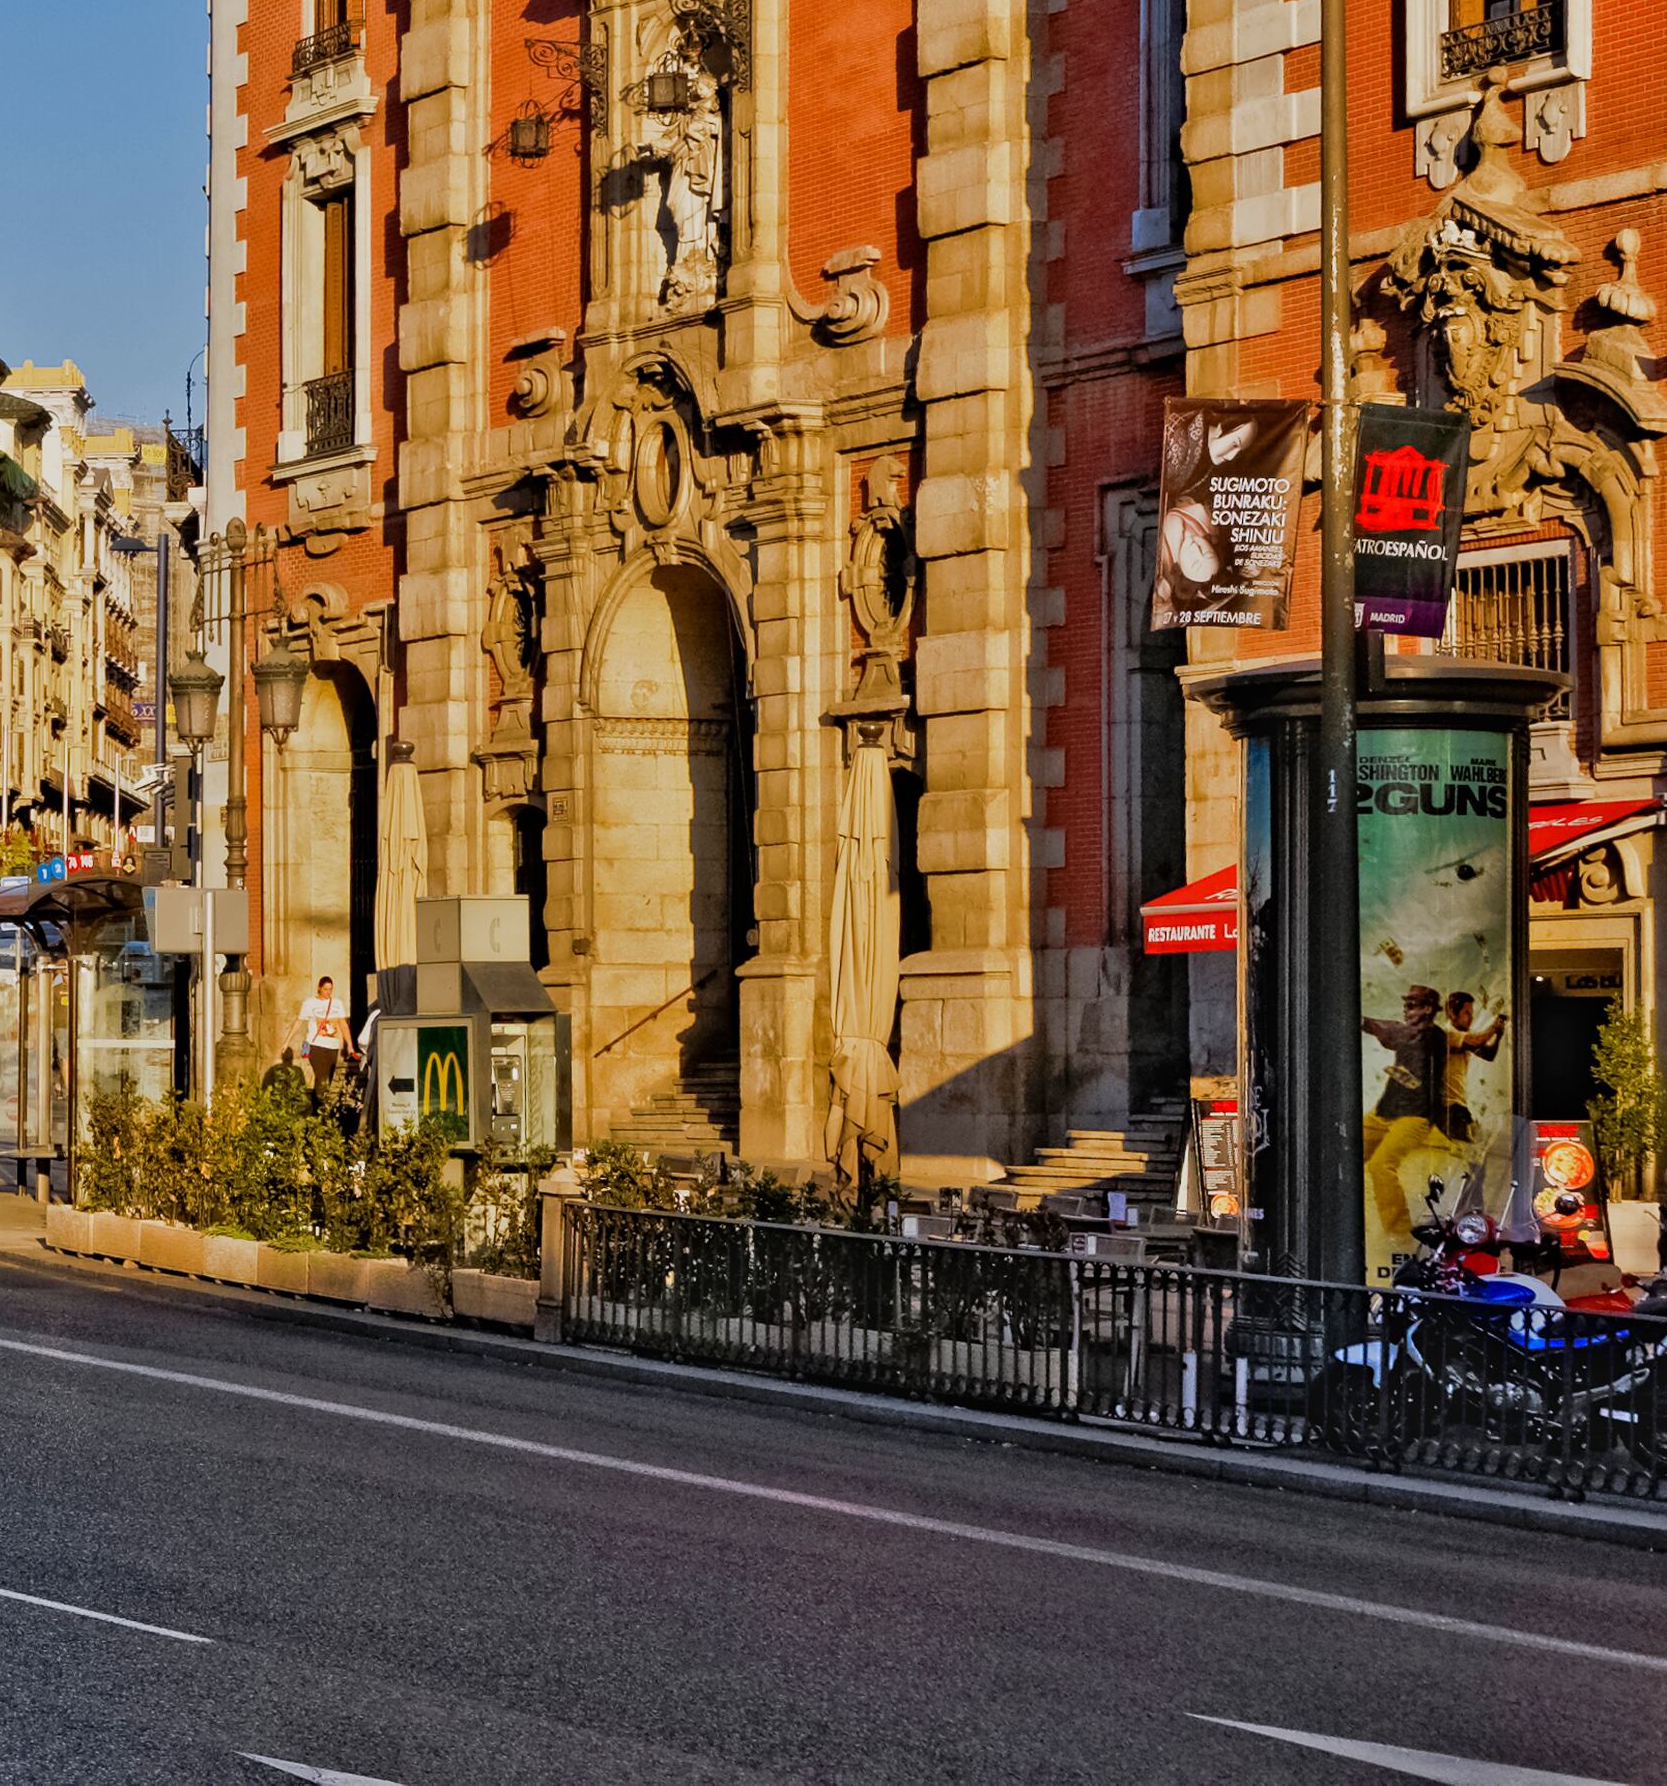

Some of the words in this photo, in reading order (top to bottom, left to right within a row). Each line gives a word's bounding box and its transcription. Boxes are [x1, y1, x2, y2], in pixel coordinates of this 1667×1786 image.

[1209, 476, 1291, 494] SUGIMOTO
[1213, 494, 1288, 511] BUNRAKU:
[1211, 510, 1287, 527] SONEZAKI
[1230, 527, 1284, 545] SHINJU
[1353, 538, 1449, 561] ATROESPAÑOL
[1179, 611, 1192, 624] 28
[1193, 611, 1262, 625] SEPTIEMBRE
[1369, 612, 1405, 624] MADRID
[1359, 755, 1412, 764] DENZEL
[1470, 757, 1497, 766] MARK
[1358, 764, 1440, 782] SHINGTON
[42, 867, 48, 880] 1
[54, 863, 62, 874] 2
[1147, 923, 1216, 943] RESTAURANTE
